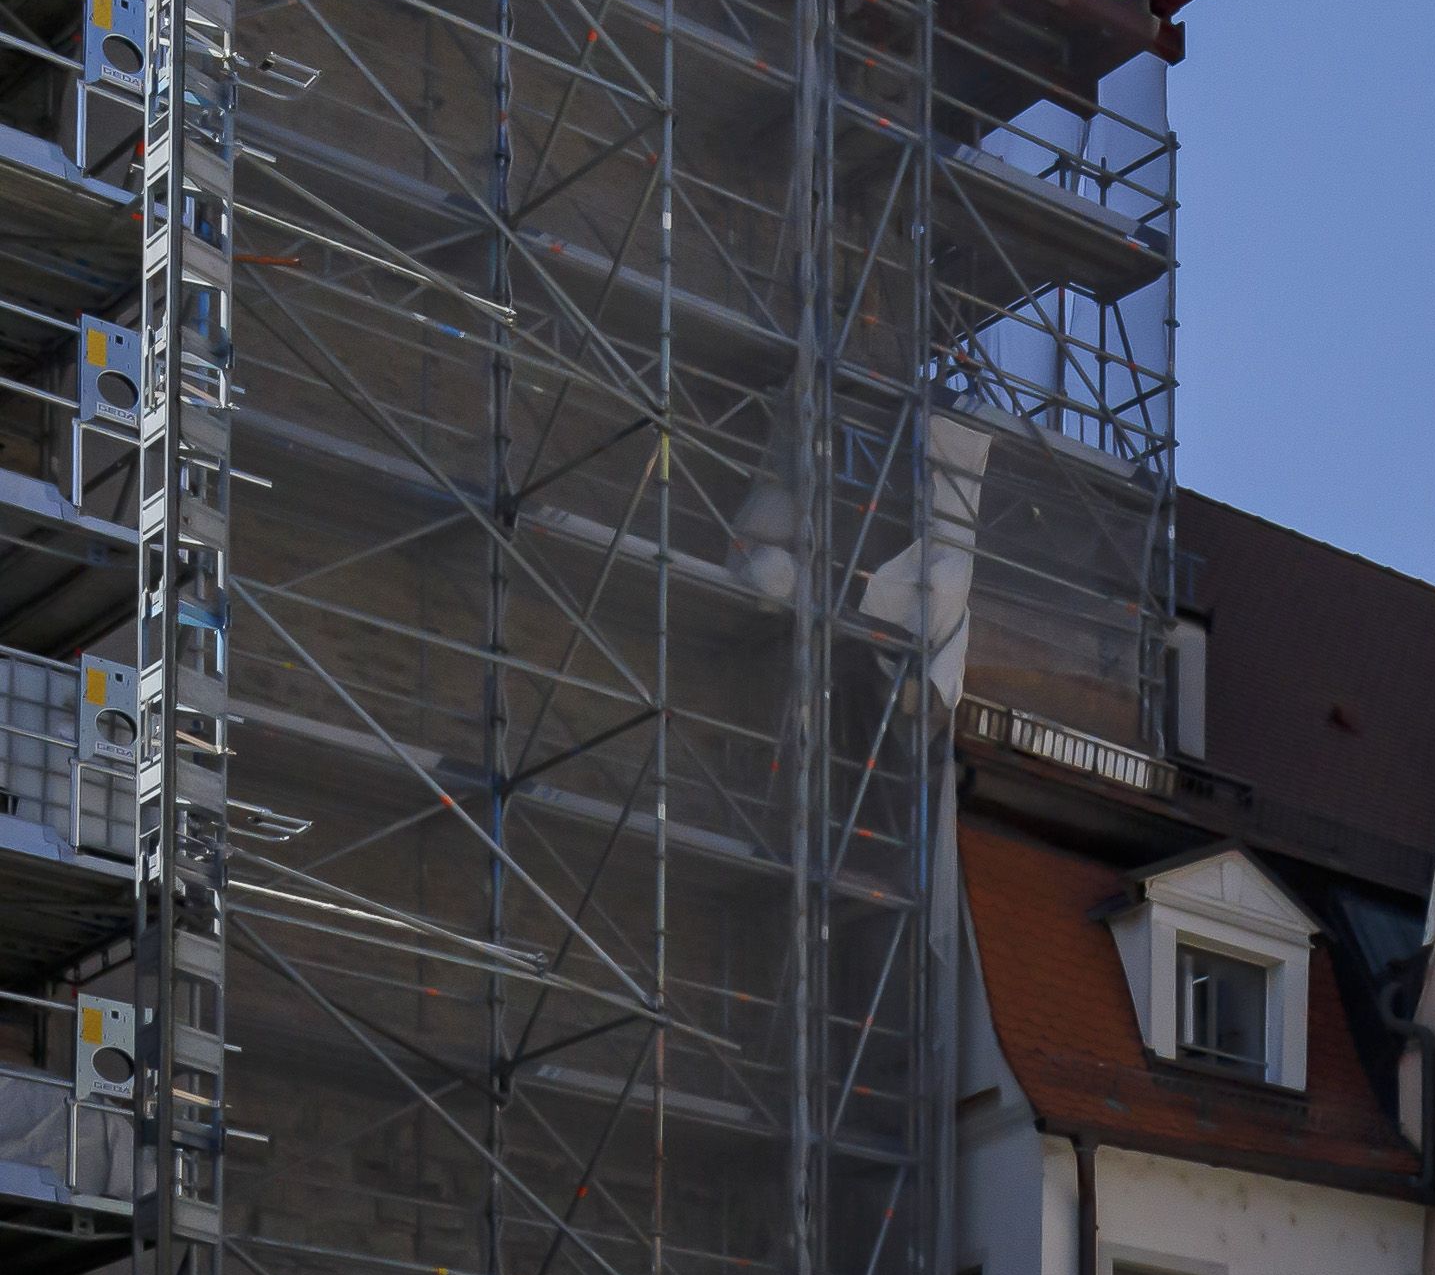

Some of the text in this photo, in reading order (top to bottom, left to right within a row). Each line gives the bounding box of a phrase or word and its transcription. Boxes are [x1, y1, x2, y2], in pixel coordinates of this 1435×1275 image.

[102, 67, 141, 87] GEDA
[98, 405, 136, 423] GEDA
[96, 742, 134, 759] GEDA
[94, 1080, 131, 1095] GEDA
